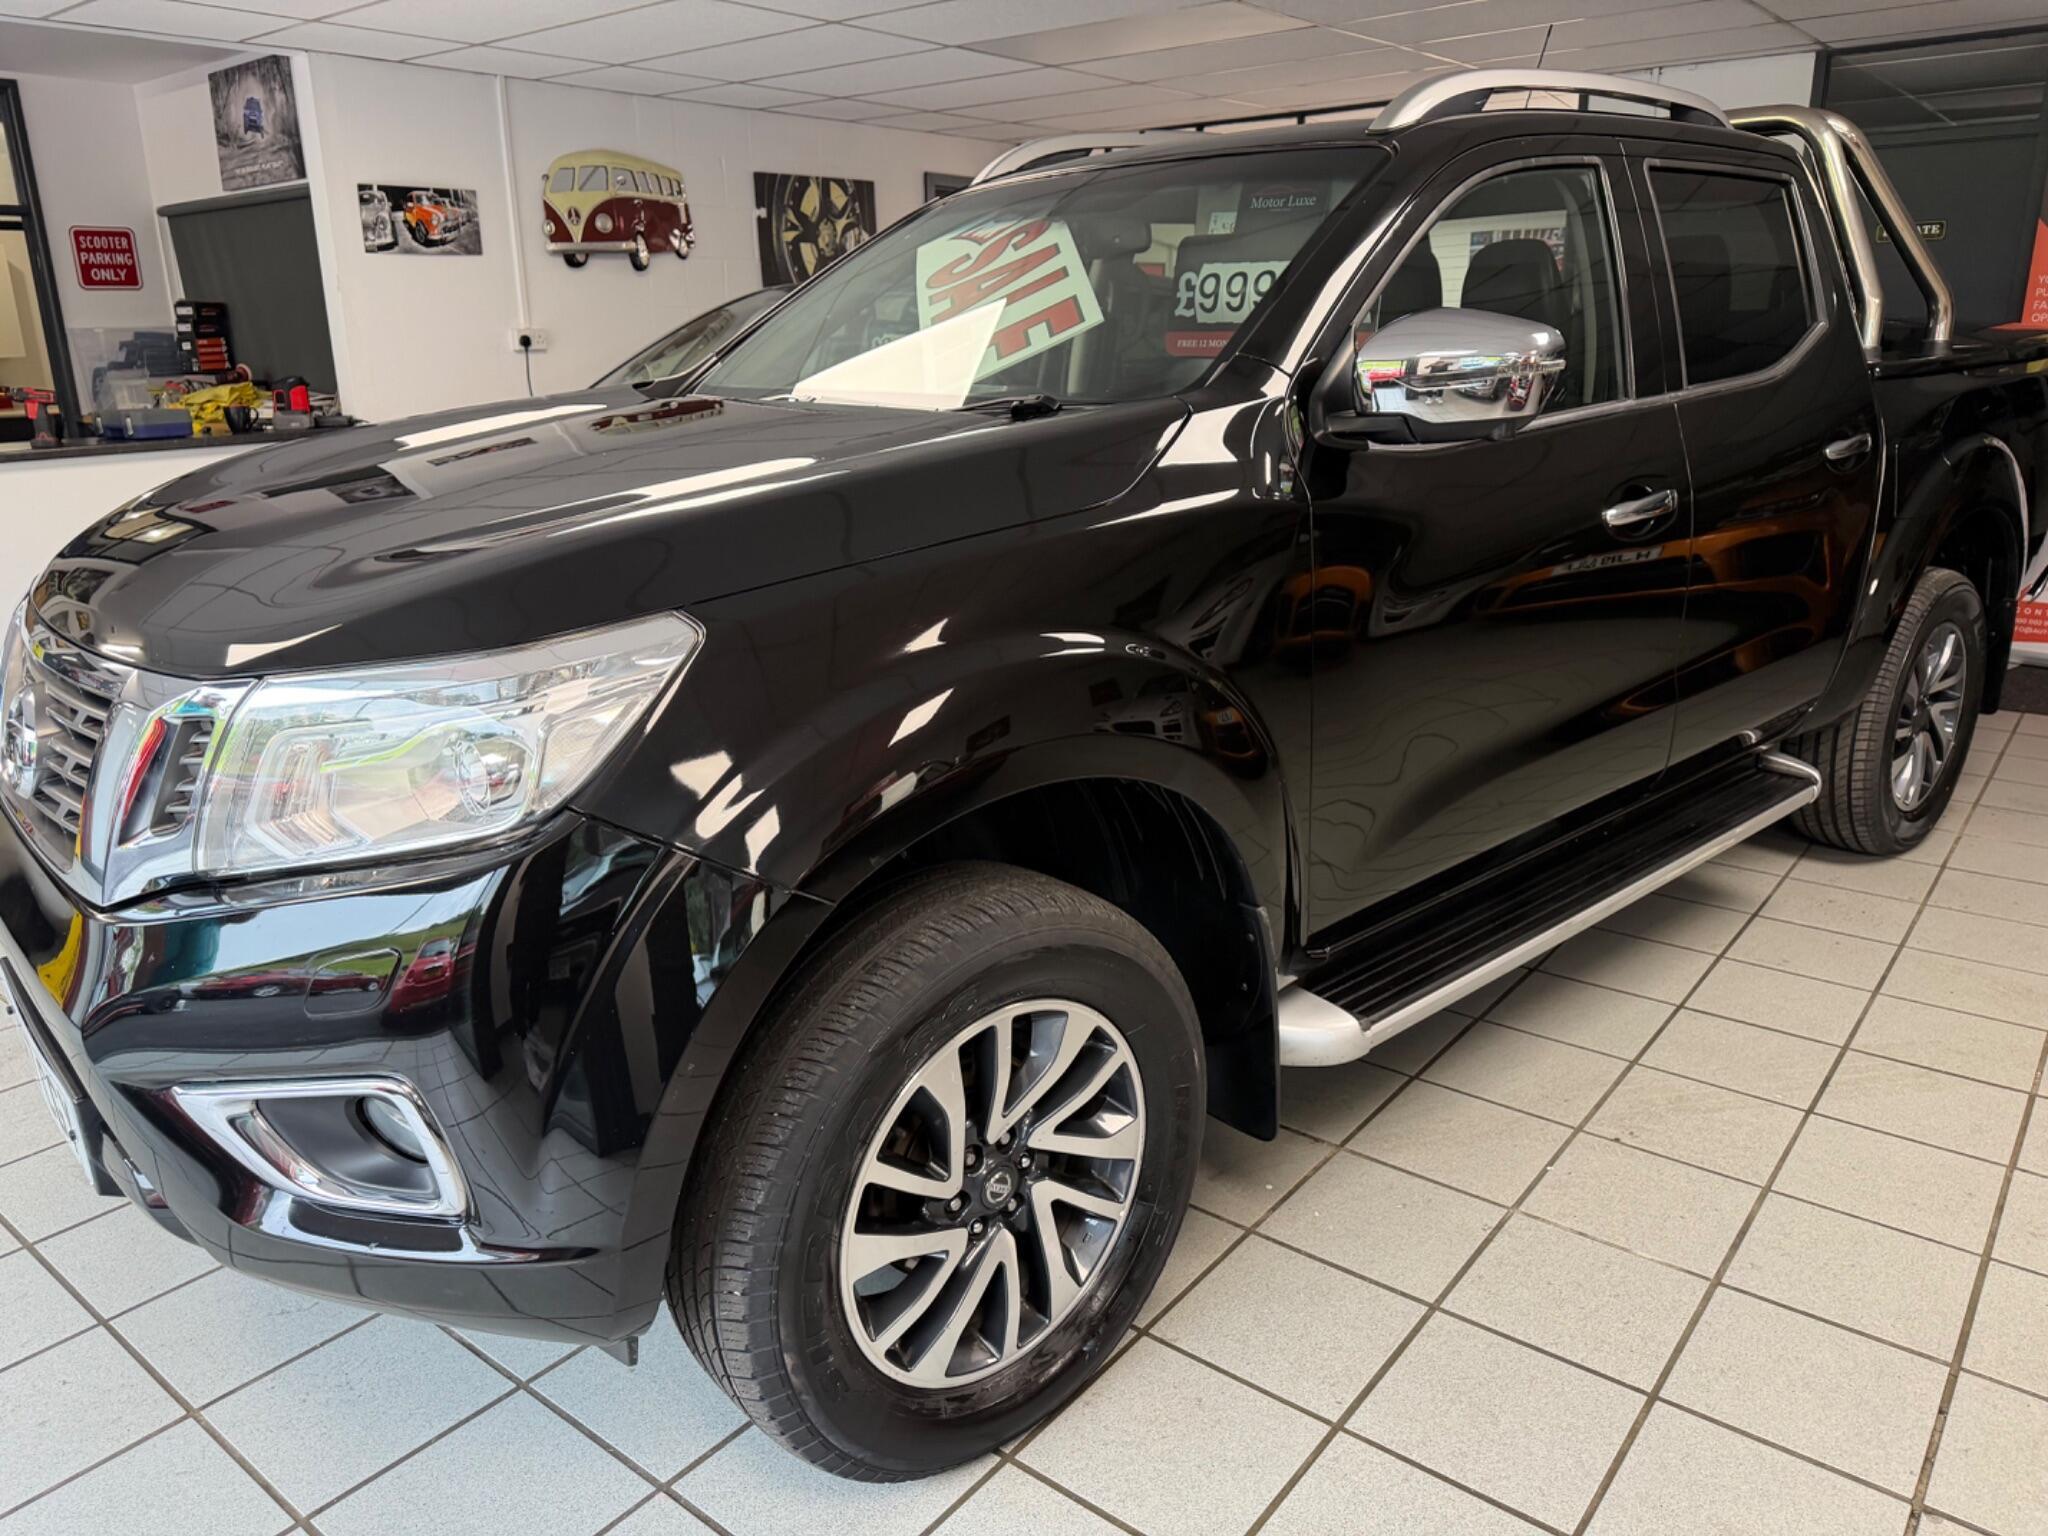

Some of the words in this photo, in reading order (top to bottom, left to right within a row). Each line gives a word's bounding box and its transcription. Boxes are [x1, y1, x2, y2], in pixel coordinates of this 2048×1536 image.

[1249, 196, 1285, 209] Motor
[1288, 195, 1316, 207] Luxe
[79, 235, 129, 249] SCOOTER
[80, 251, 133, 266] PARKING
[91, 267, 127, 281] ONLY
